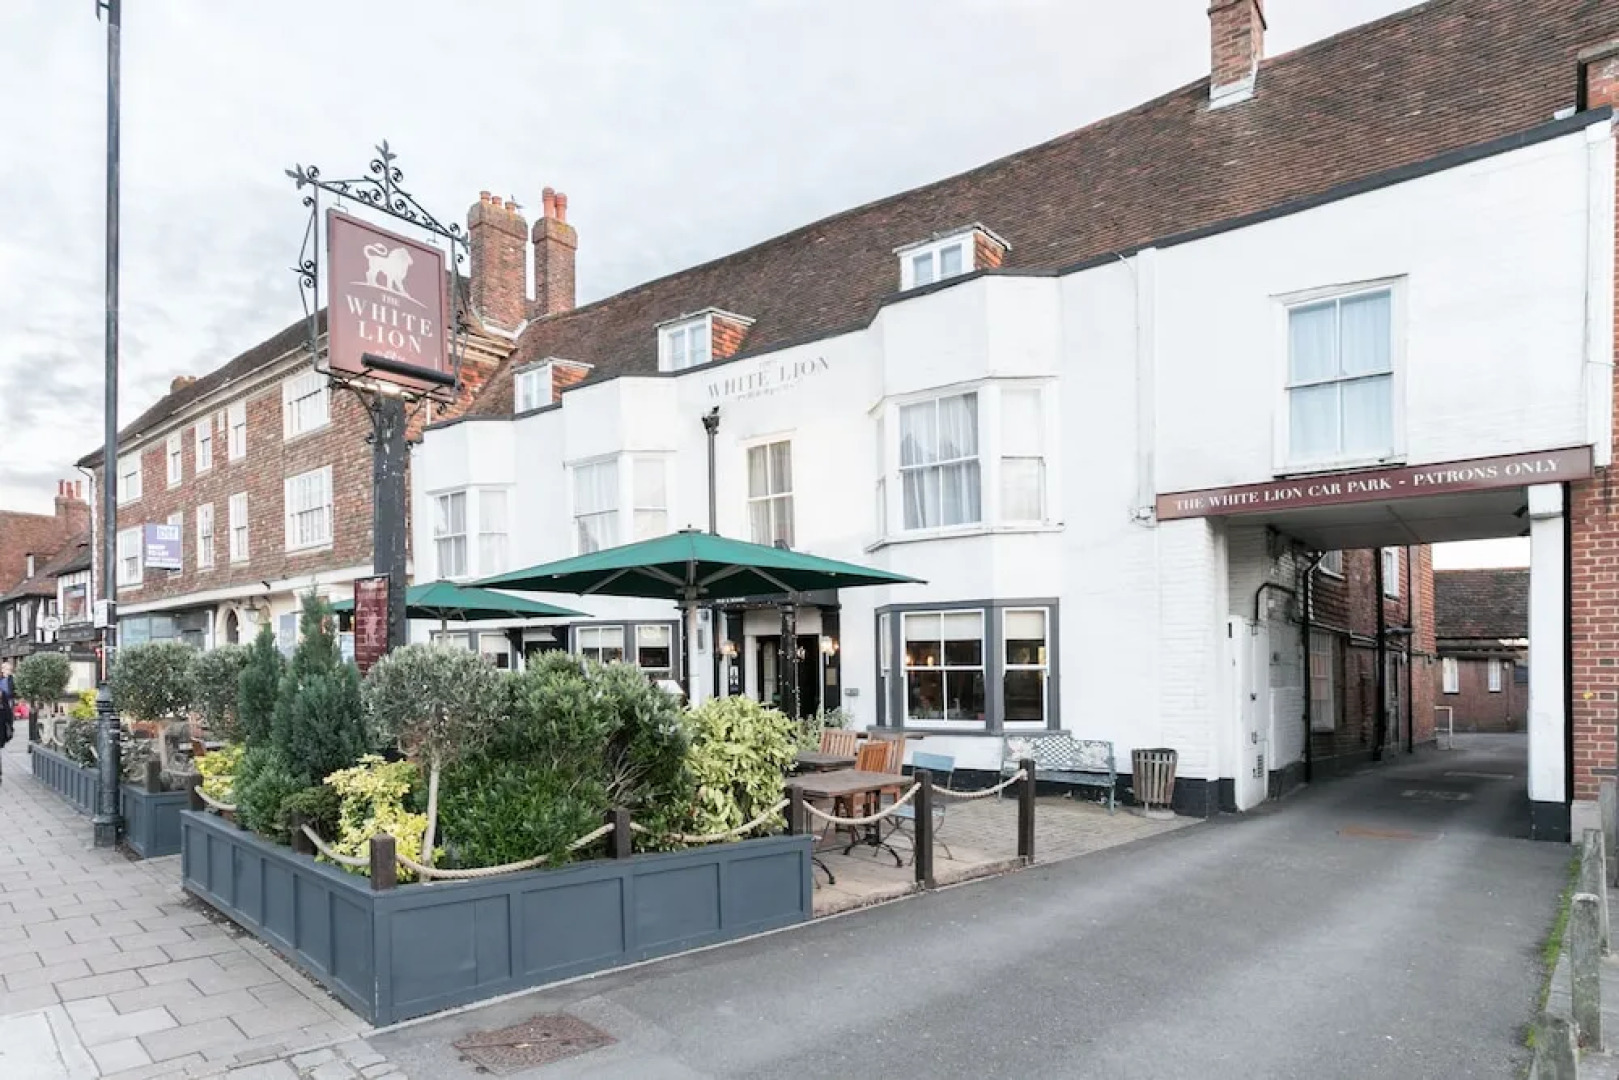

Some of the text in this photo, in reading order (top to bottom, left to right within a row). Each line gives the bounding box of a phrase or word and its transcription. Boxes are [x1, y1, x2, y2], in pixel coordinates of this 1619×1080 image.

[345, 294, 433, 338] WHITE
[359, 320, 422, 354] LION
[708, 371, 770, 398] WHITE
[780, 356, 829, 381] LION
[1175, 498, 1204, 511] THE
[1208, 491, 1260, 507] WHITE
[1263, 487, 1303, 502] LION
[1307, 483, 1342, 497] CAR
[1347, 476, 1392, 493] PARK
[1413, 465, 1498, 487] PATRONS
[1504, 458, 1561, 477] ONLY
